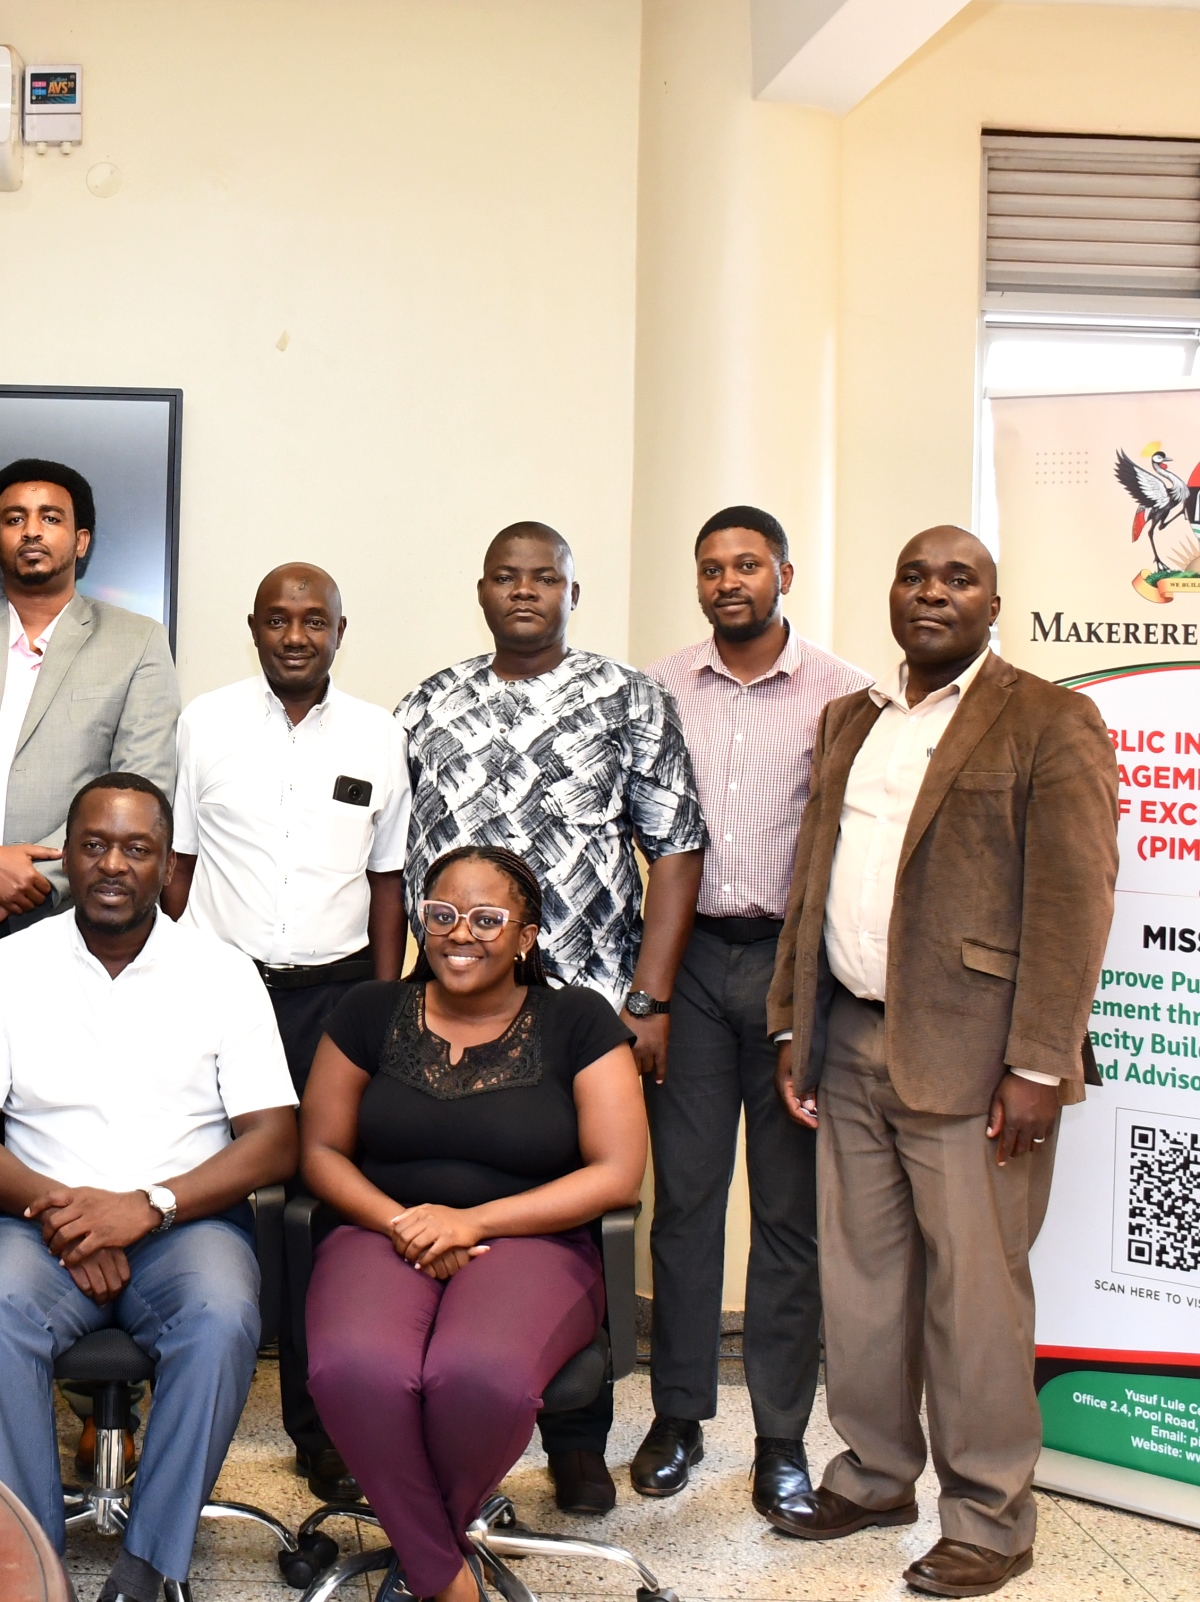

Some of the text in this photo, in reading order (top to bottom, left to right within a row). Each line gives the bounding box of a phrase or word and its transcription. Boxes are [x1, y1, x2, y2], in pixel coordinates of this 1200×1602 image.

[48, 81, 68, 94] AVS
[1117, 764, 1200, 790] AGEM
[1143, 924, 1200, 953] MIS
[1151, 1033, 1200, 1058] Buil
[1094, 1279, 1125, 1294] SCAN
[1130, 1286, 1160, 1300] HERE
[1165, 1293, 1181, 1304] TO
[1073, 1392, 1199, 1433] Office 2.4, Pool Road,
[1125, 1389, 1157, 1405] Yusuf
[1161, 1397, 1186, 1412] Lule
[1151, 1425, 1187, 1443] Email:
[1131, 1436, 1183, 1458] Website:
